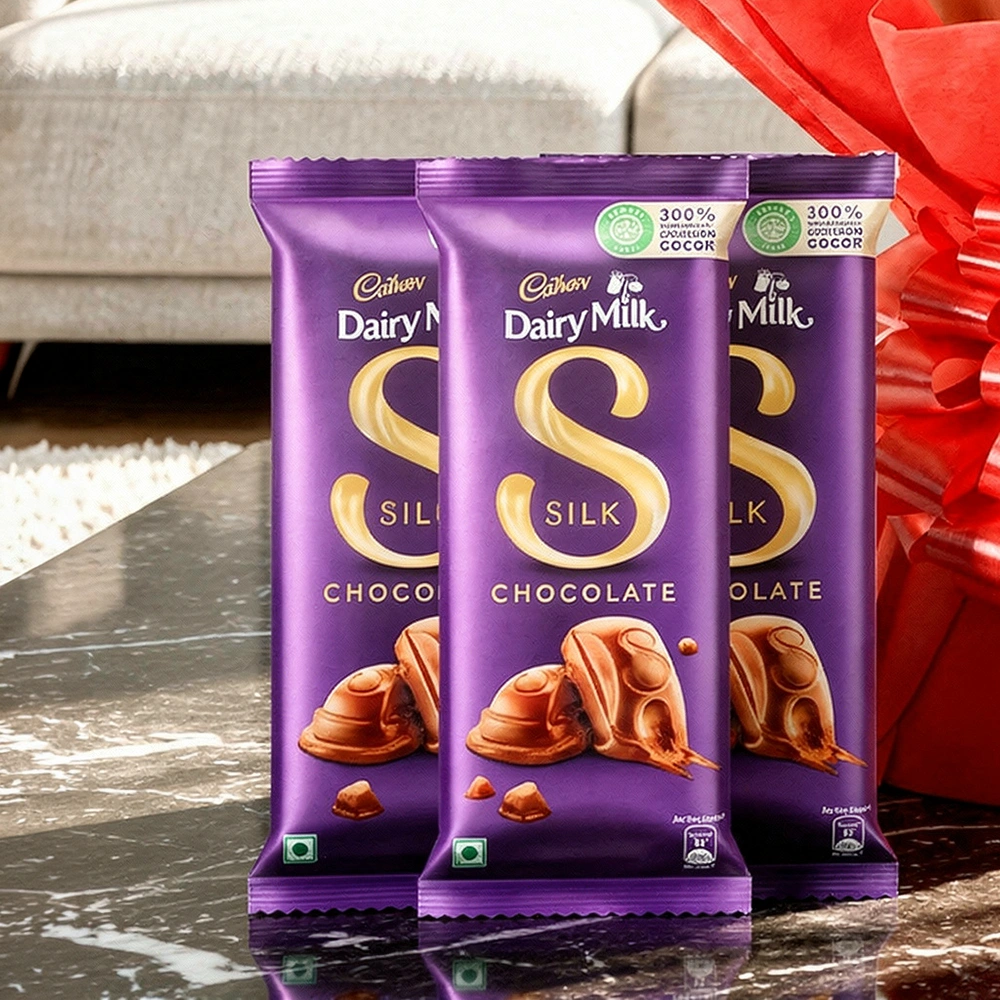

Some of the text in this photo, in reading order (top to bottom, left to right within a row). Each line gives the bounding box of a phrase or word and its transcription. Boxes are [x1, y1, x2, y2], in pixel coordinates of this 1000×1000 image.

[659, 207, 716, 222] 300%
[808, 204, 863, 220] 300%
[504, 297, 668, 343] Dairy Milk
[738, 296, 815, 330] Milk
[337, 310, 422, 343] Dairy
[496, 345, 670, 569] S
[379, 500, 439, 526] SIL
[545, 500, 620, 526] SILK
[729, 500, 767, 524] LK
[323, 582, 435, 603] CHOCO
[491, 582, 676, 603] CHOCOLATE
[729, 580, 822, 601] OLATE
